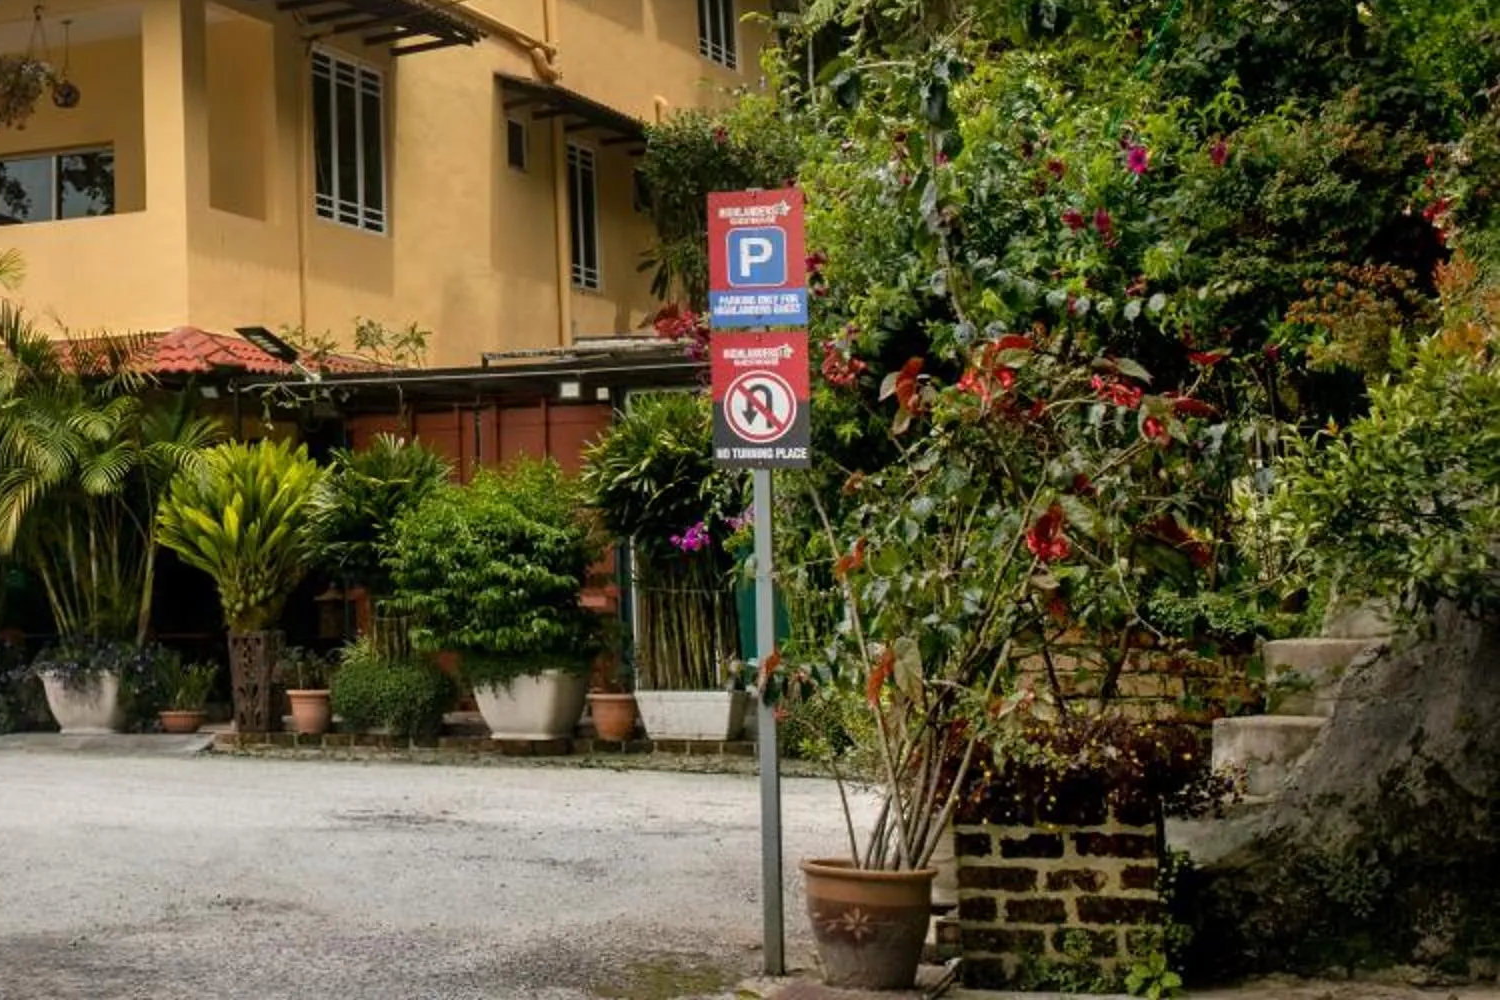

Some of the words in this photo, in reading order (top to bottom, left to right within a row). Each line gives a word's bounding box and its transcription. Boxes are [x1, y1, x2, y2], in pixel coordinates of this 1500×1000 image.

[739, 237, 773, 277] P
[716, 447, 730, 459] NO
[732, 447, 773, 459] TURNING
[775, 447, 808, 459] PLACE
